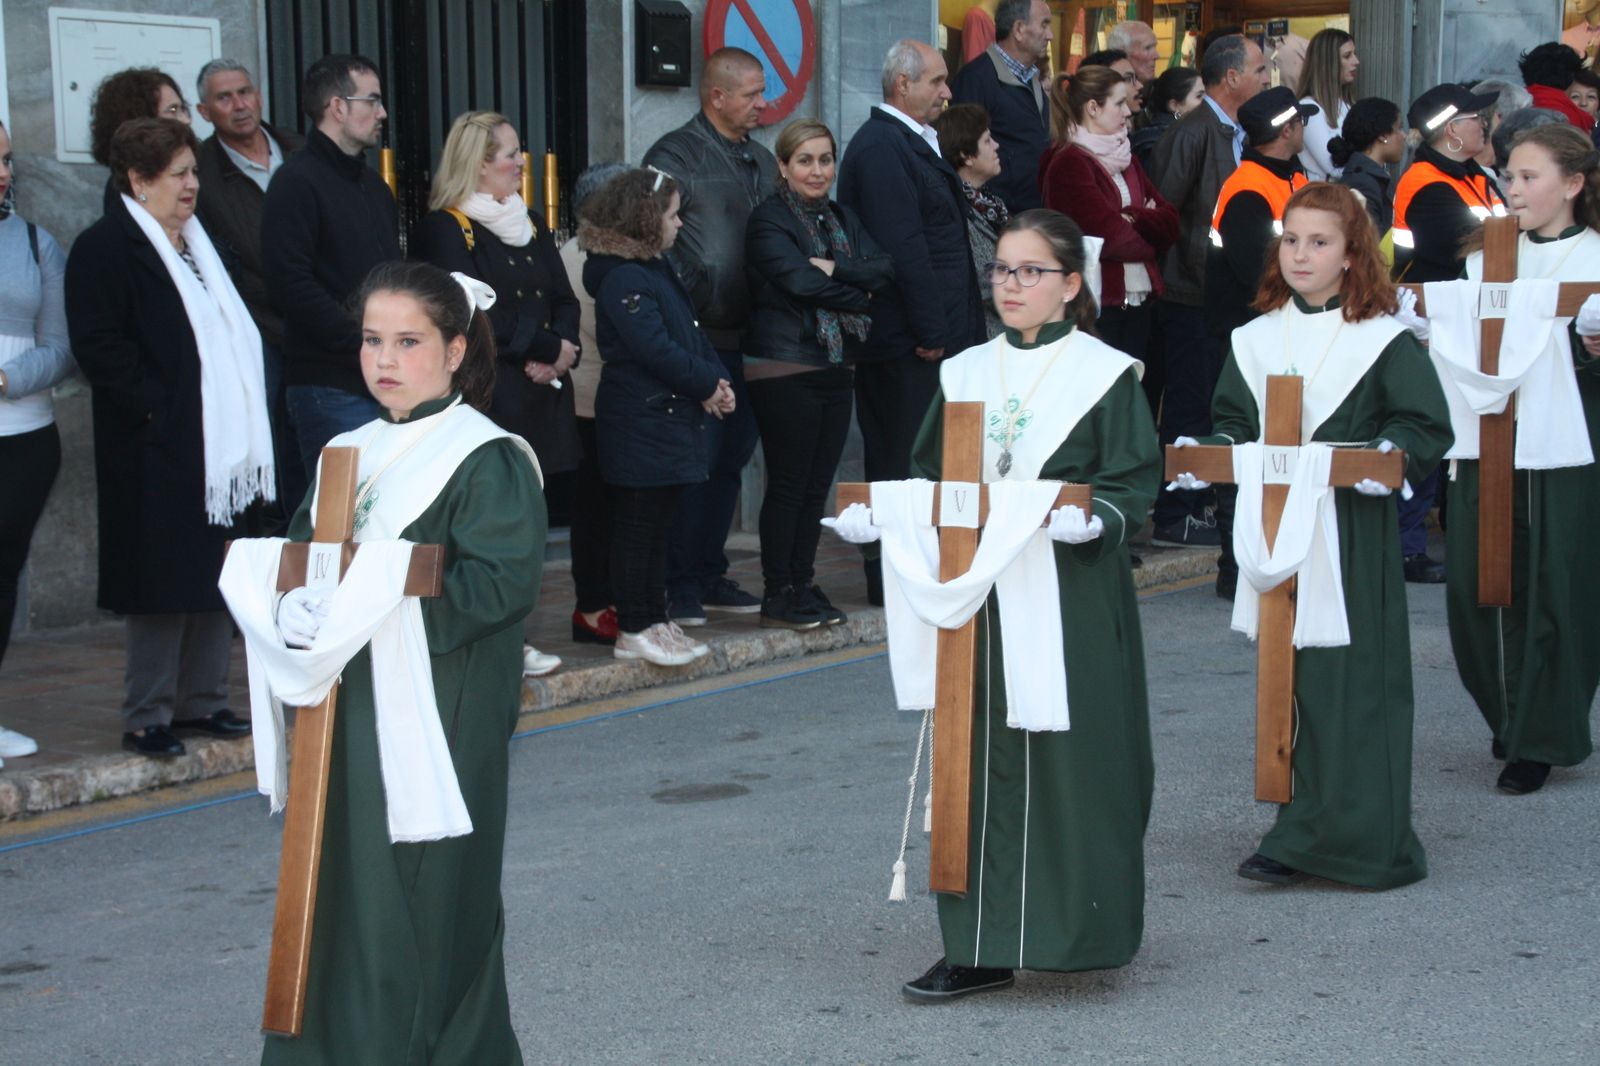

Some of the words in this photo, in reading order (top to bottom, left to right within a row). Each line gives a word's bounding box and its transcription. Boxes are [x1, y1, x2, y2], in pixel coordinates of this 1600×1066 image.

[1490, 289, 1508, 308] VII
[1271, 453, 1288, 474] VI
[954, 489, 967, 513] V
[314, 552, 332, 579] IV
